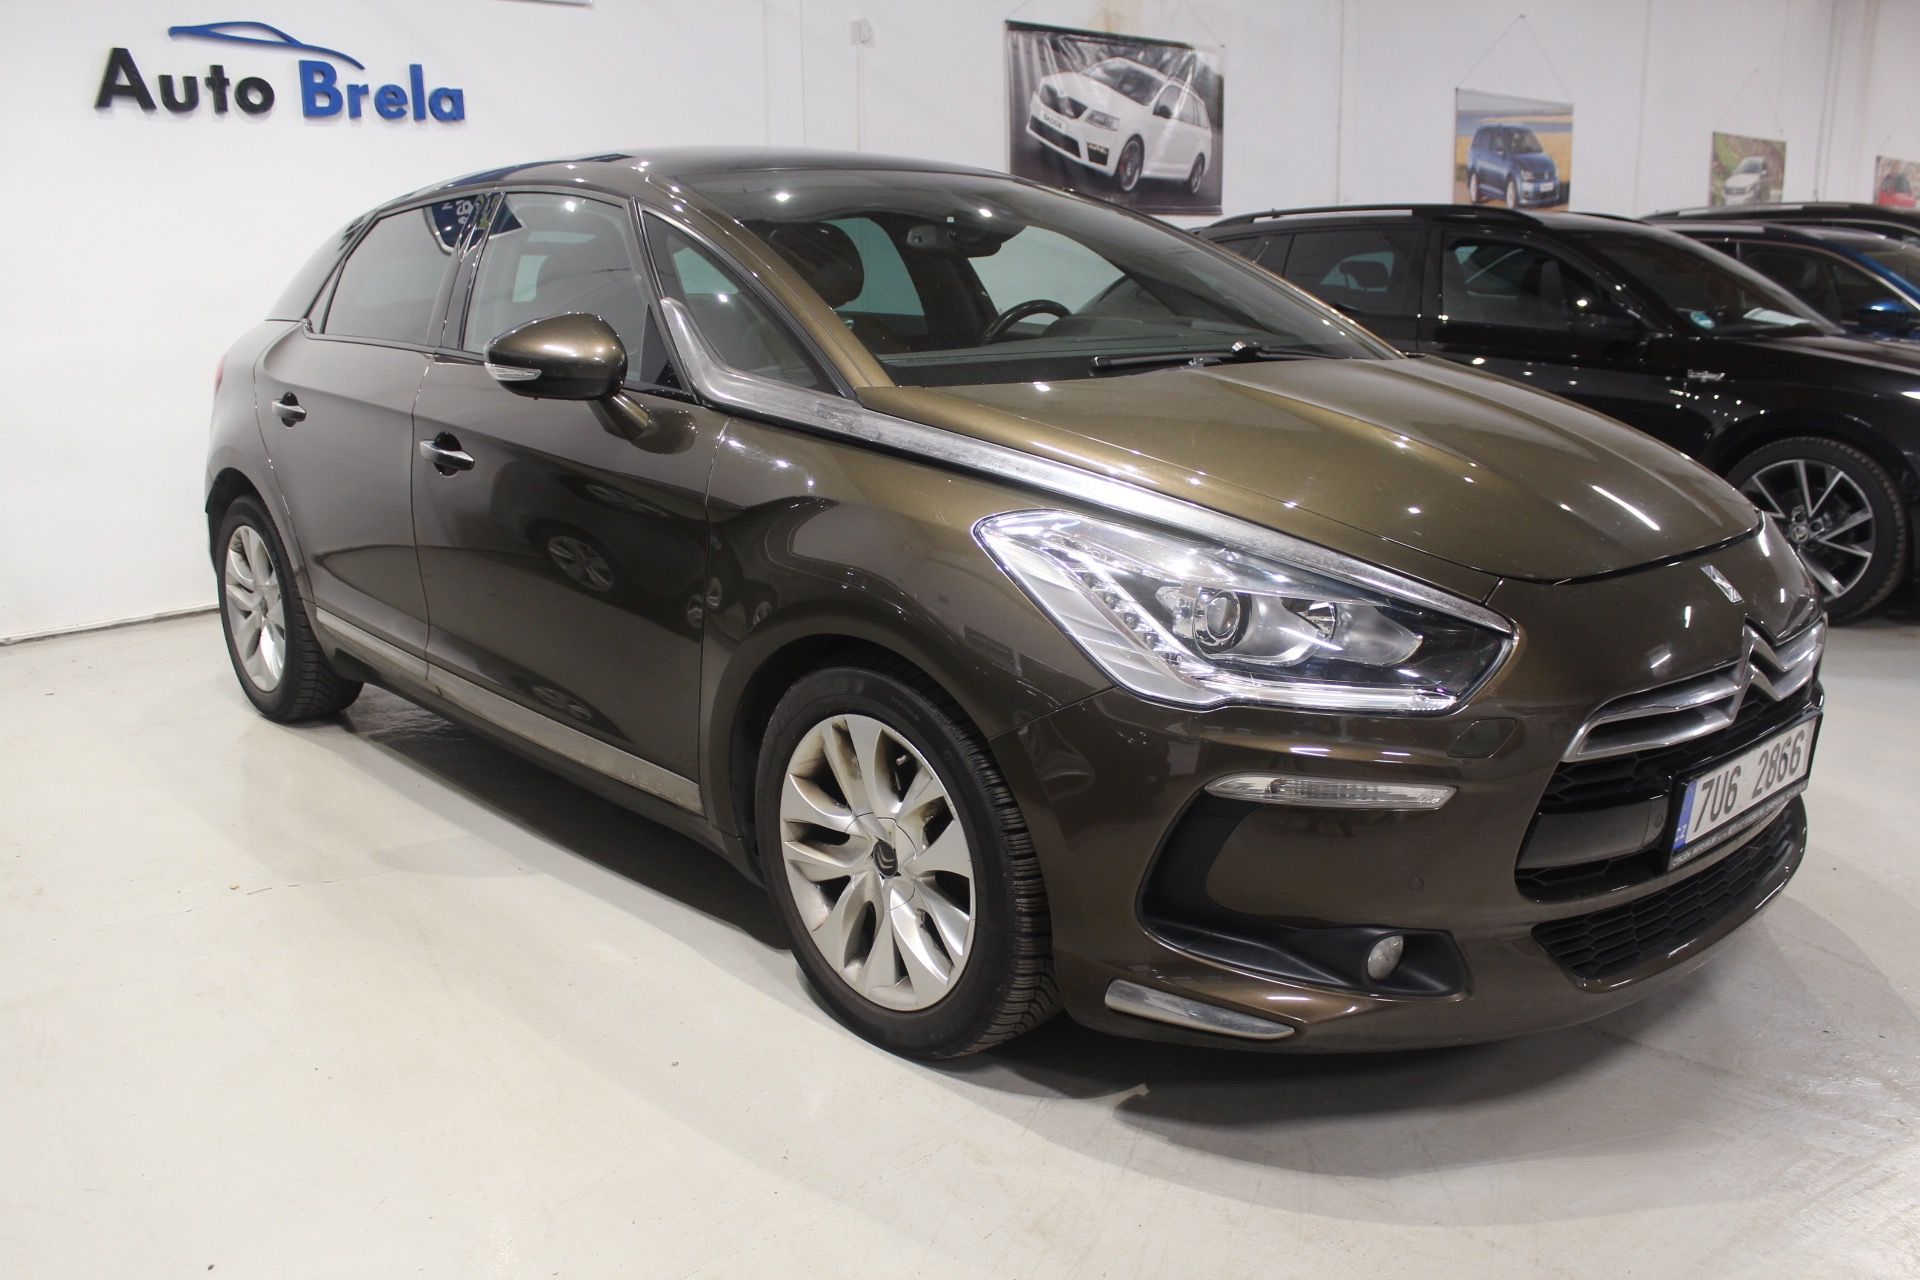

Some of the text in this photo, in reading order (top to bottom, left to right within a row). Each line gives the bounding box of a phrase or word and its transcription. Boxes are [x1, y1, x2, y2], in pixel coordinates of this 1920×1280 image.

[94, 47, 465, 121] Auto Brela
[1693, 765, 1742, 833] 7U6
[1751, 729, 1805, 799] 2866
[1674, 823, 1688, 842] CZ
